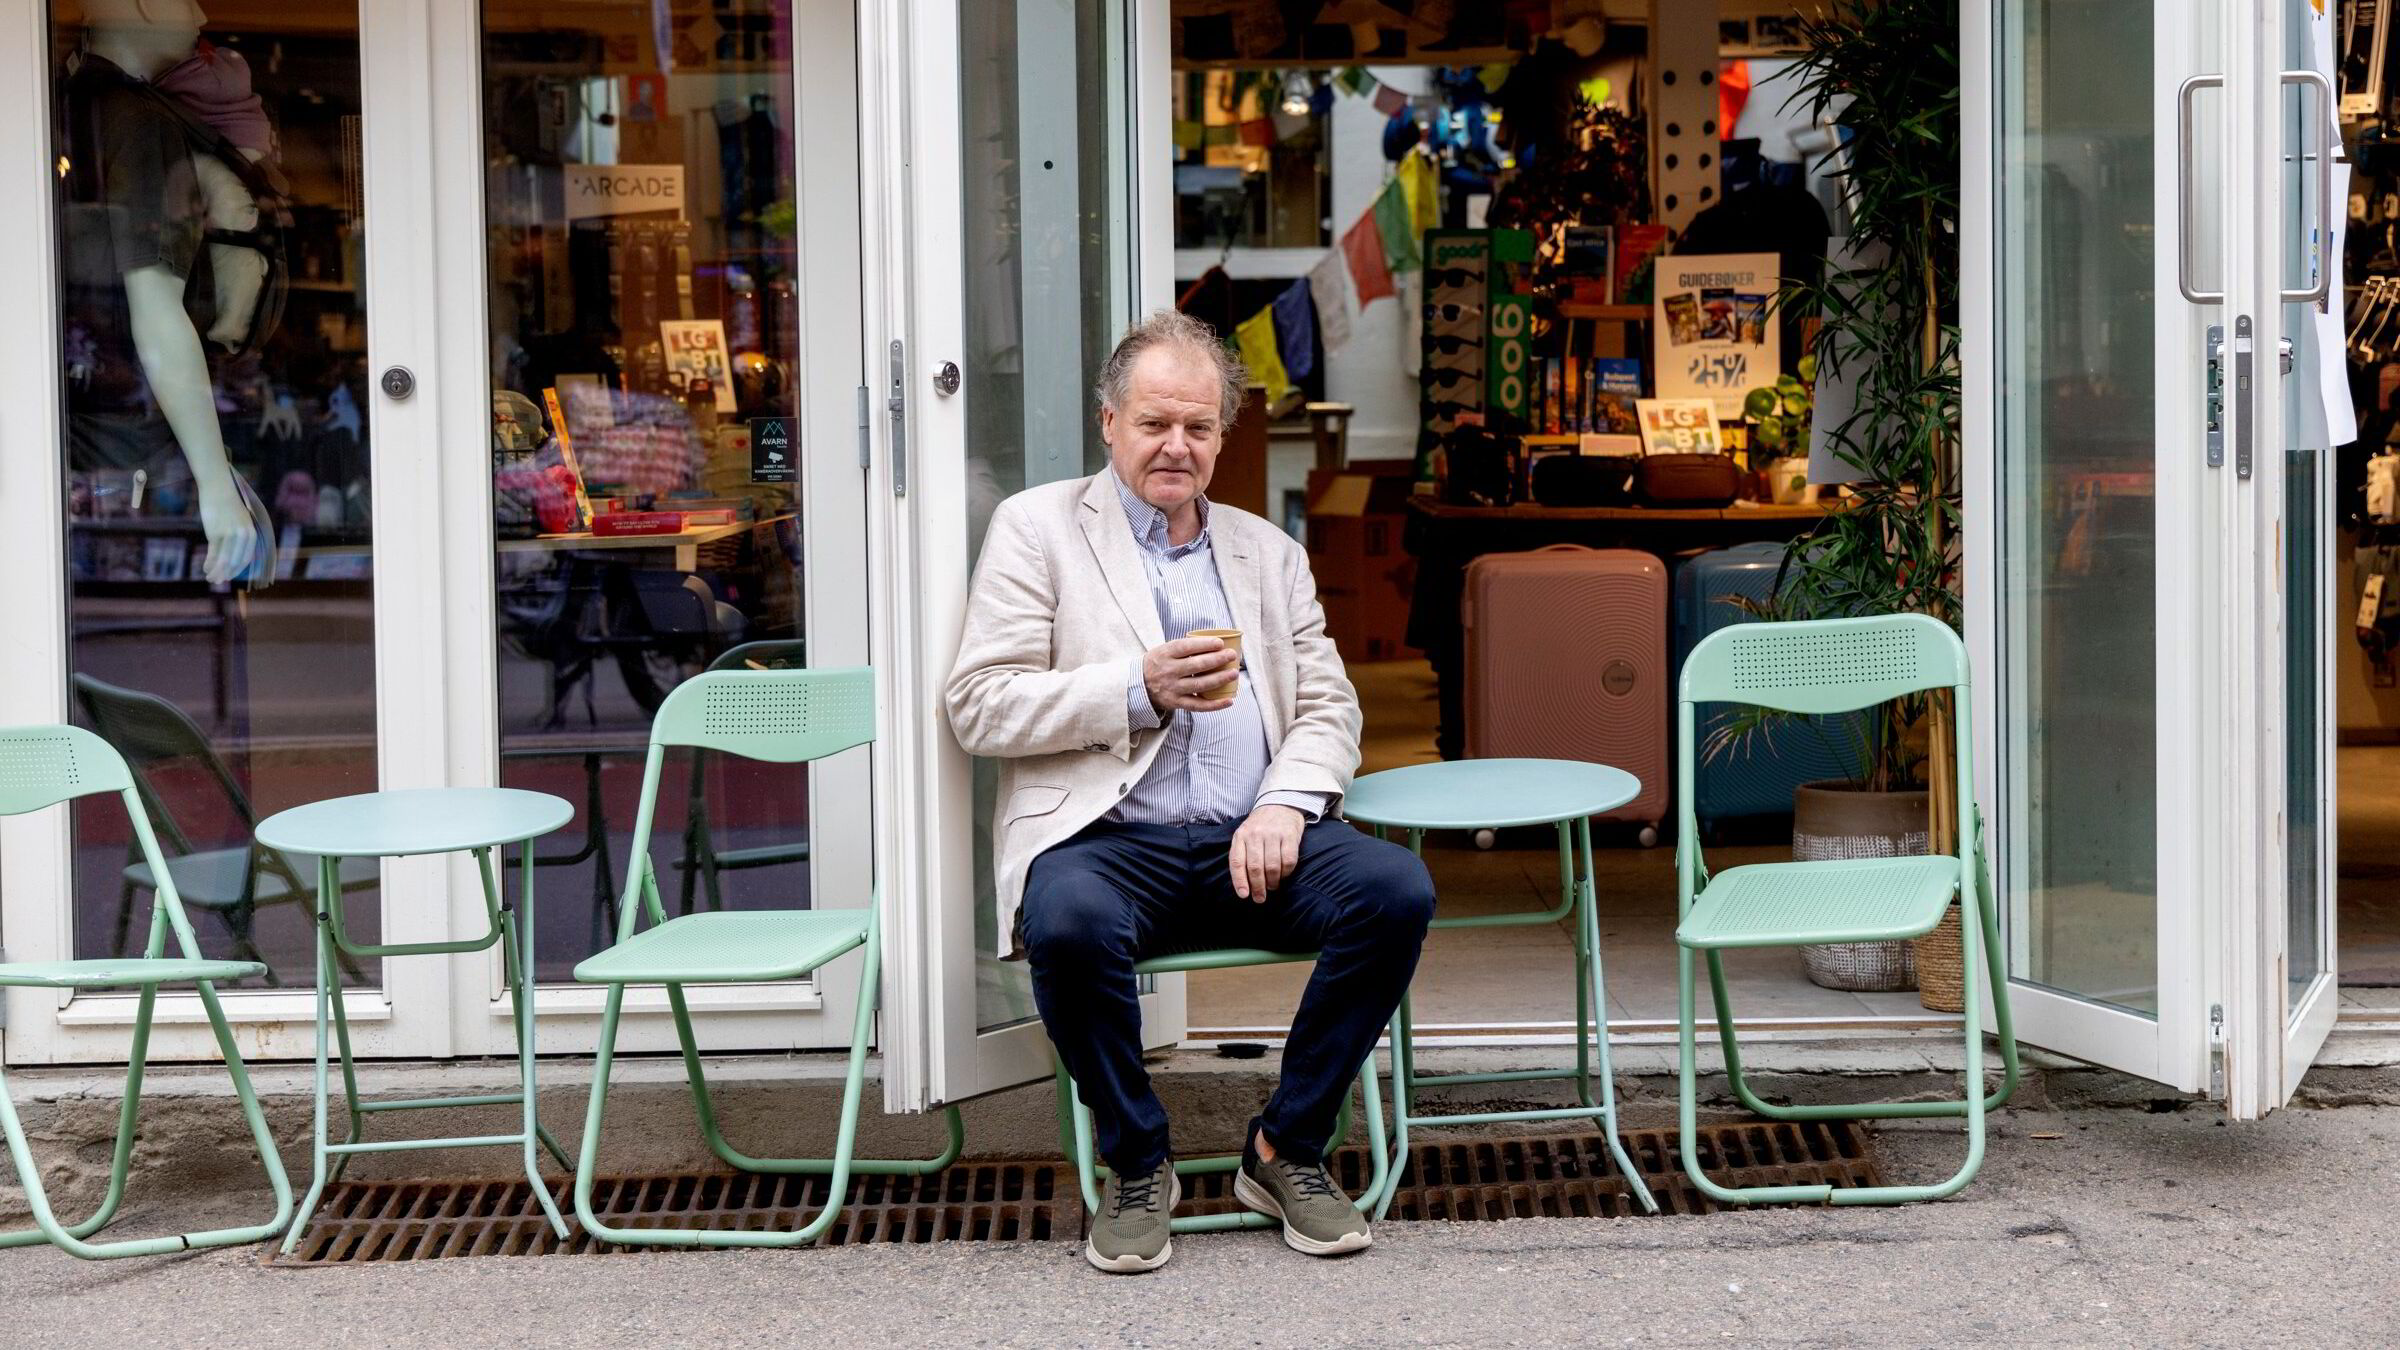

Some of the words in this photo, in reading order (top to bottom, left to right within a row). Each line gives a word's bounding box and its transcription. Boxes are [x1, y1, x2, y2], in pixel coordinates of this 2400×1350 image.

[1678, 272, 1755, 288] GUIDEBØKER
[1603, 371, 1636, 382] Budapest
[1688, 352, 1747, 389] 25%
[1658, 407, 1695, 427] LG
[1674, 427, 1711, 448] BT
